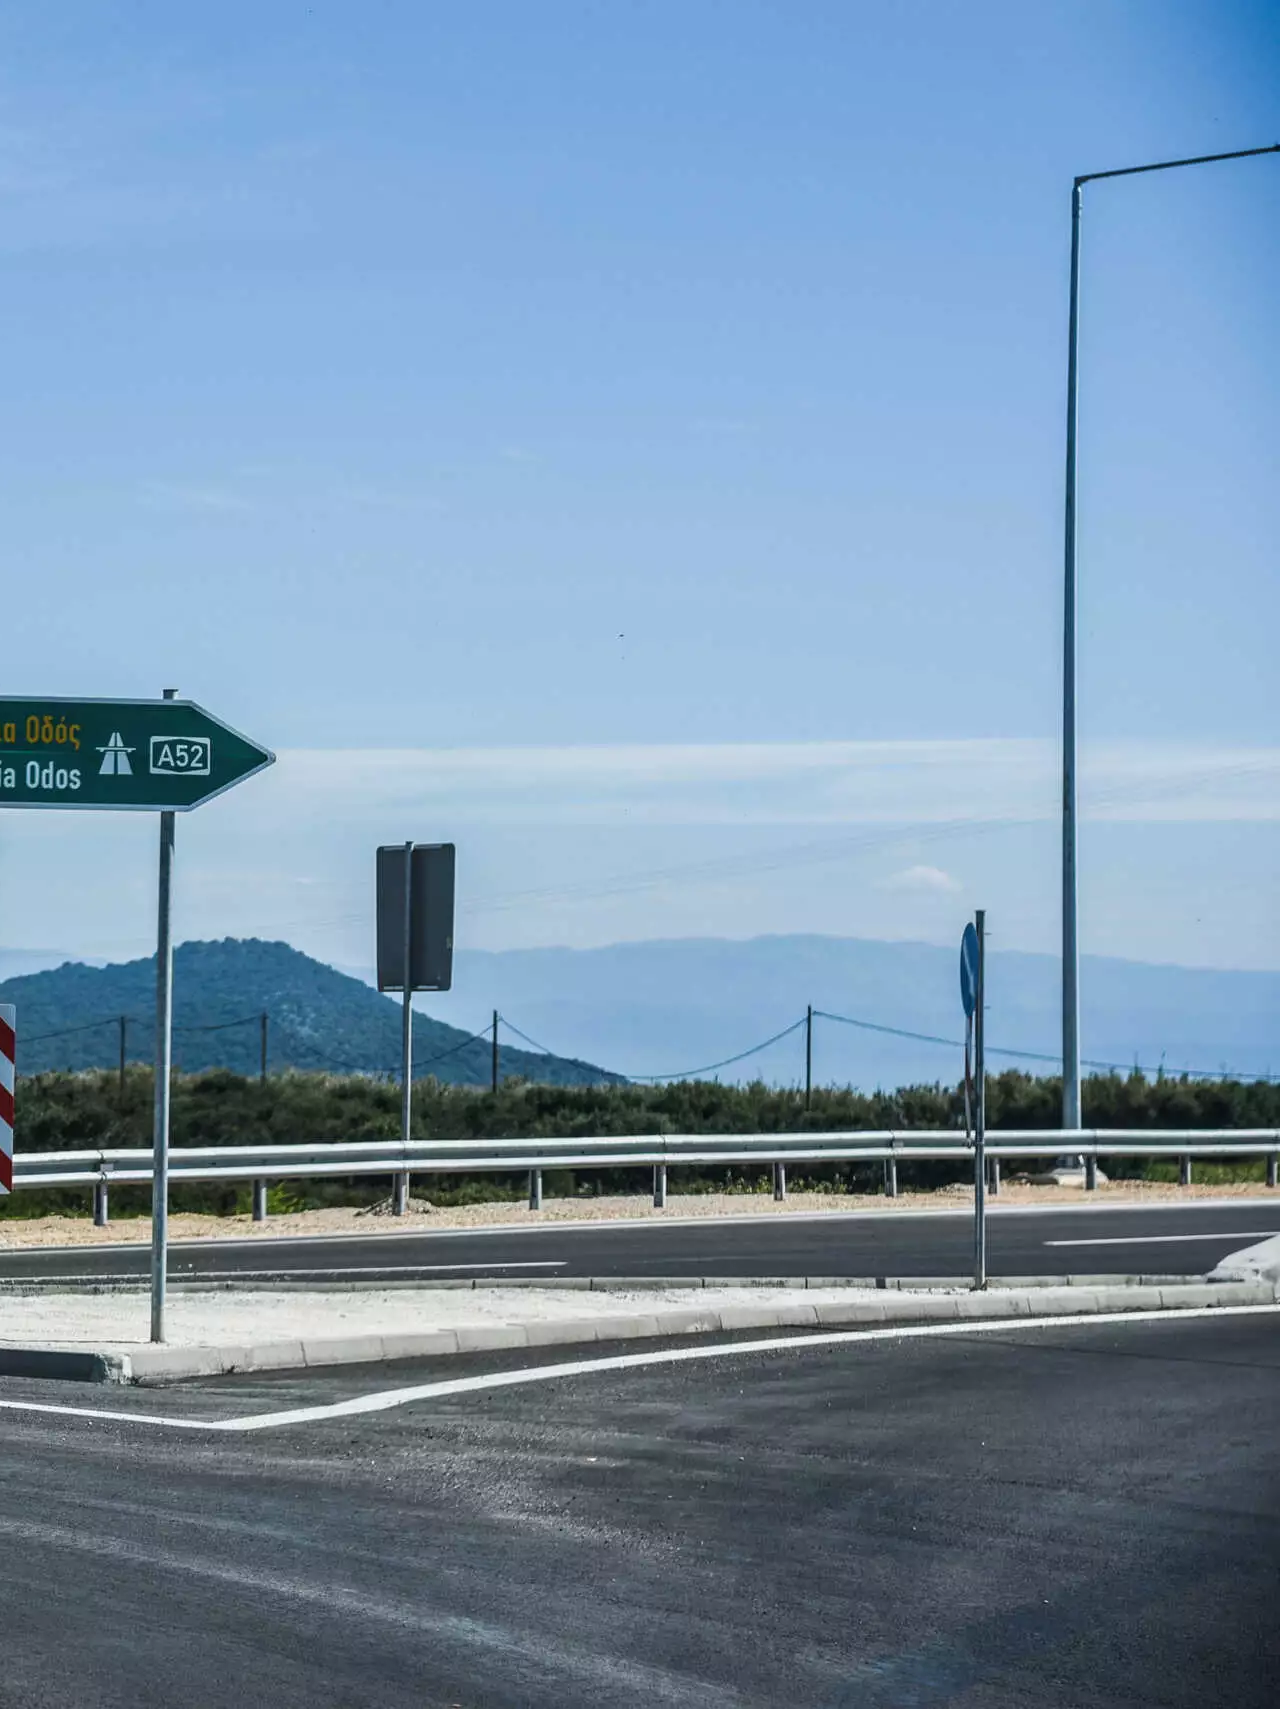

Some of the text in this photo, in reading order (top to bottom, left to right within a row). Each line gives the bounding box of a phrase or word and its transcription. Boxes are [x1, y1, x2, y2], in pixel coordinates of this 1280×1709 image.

[25, 714, 81, 750] Οδός
[157, 743, 204, 768] A52
[25, 760, 81, 790] Odos
